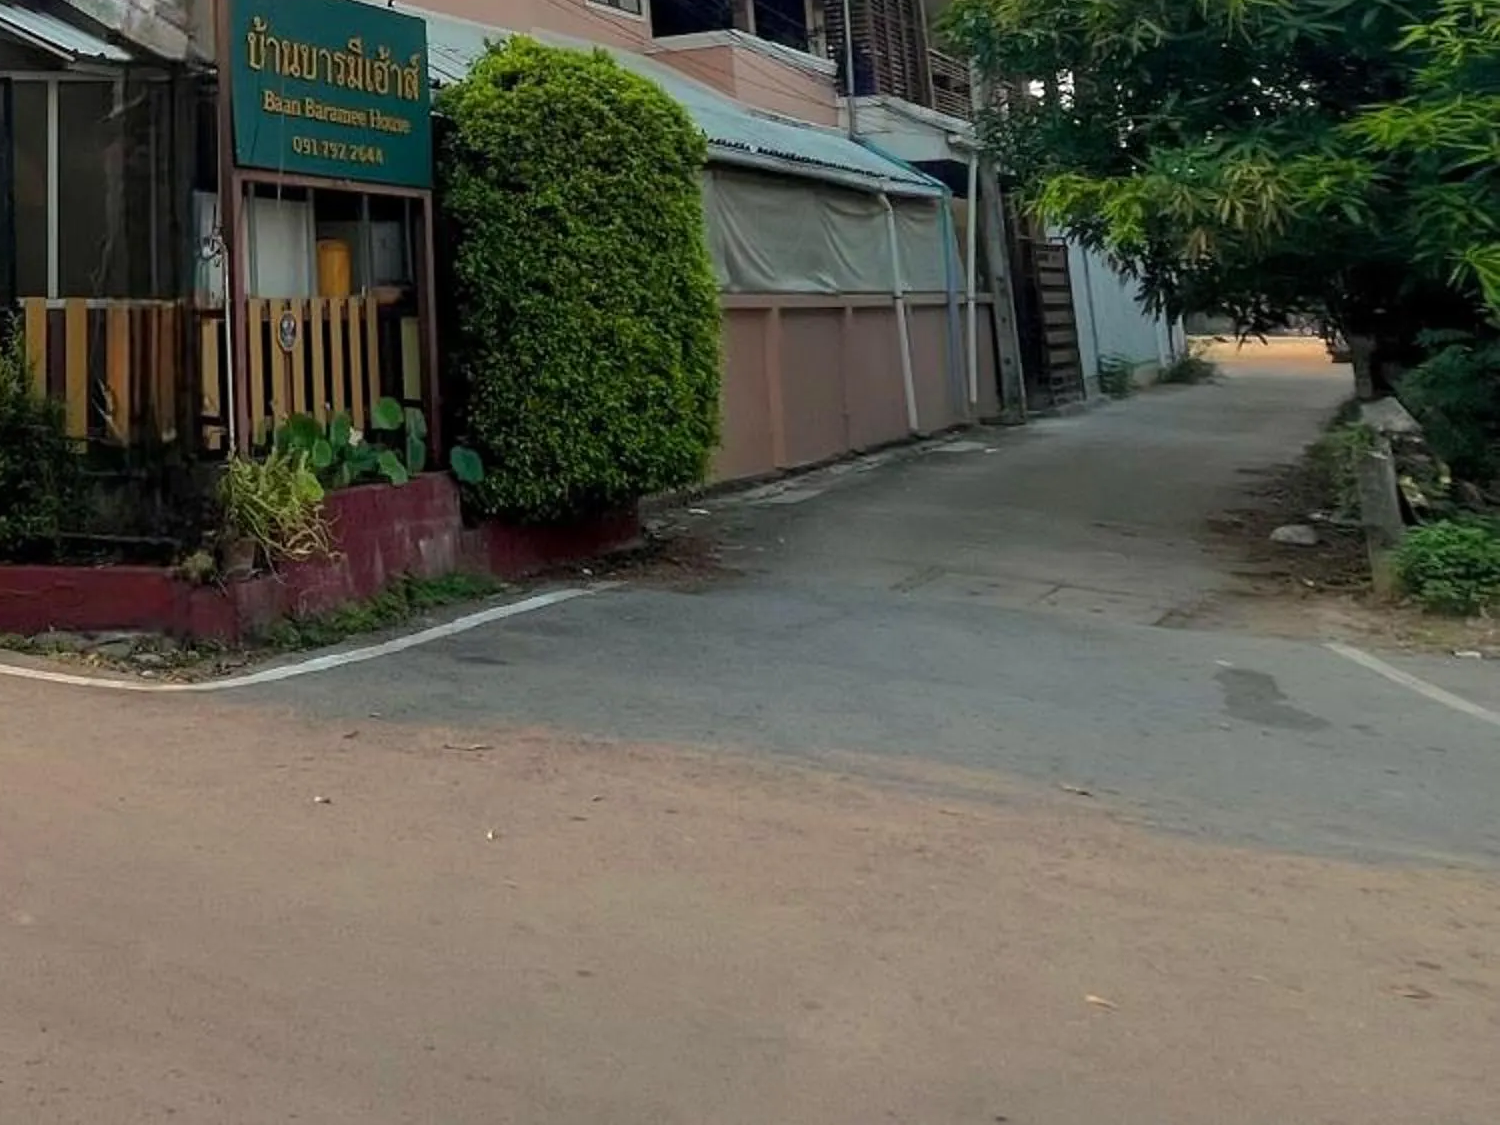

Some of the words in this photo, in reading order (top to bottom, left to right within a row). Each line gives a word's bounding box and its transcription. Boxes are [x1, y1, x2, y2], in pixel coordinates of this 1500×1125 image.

[264, 90, 300, 115] Baan
[305, 97, 367, 125] Baramee
[292, 135, 318, 156] 091
